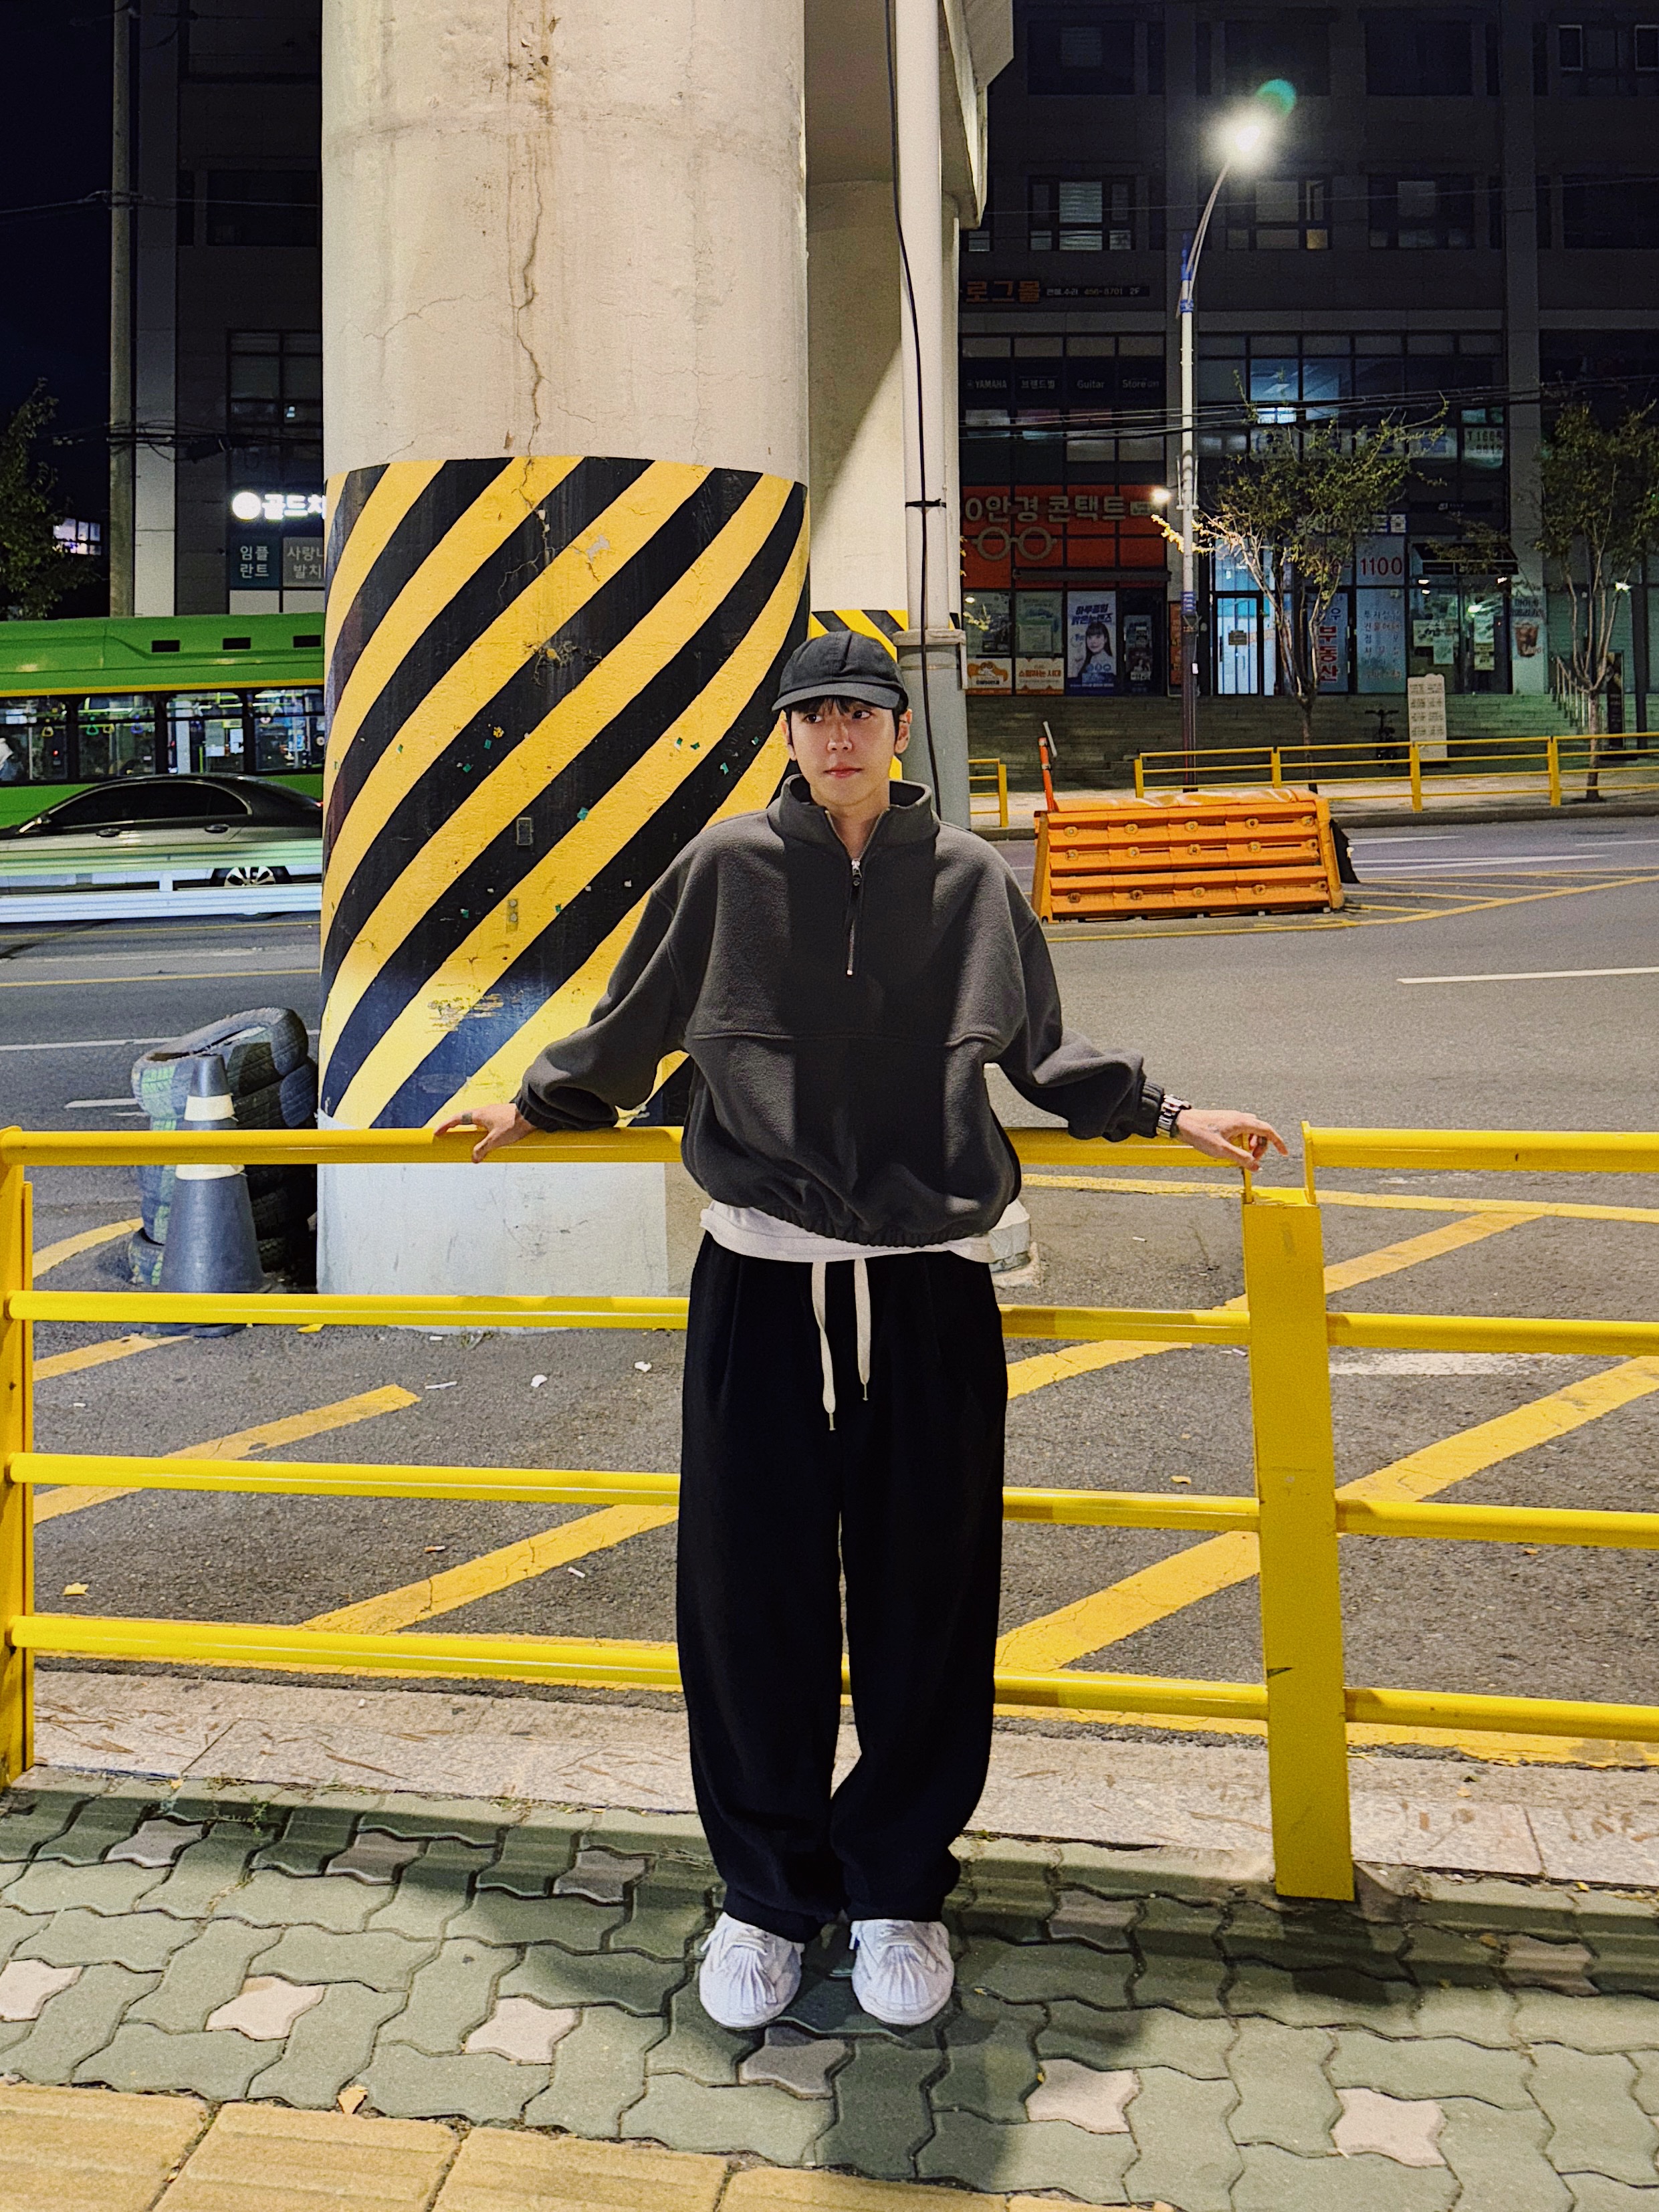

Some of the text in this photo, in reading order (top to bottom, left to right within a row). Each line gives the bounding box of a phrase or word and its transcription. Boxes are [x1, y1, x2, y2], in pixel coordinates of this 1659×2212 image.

[975, 379, 1007, 389] YAMAHA
[1077, 379, 1105, 389] Guitar
[1048, 495, 1127, 523] 콘택트
[240, 546, 269, 561] 임플
[240, 564, 269, 578] 란트
[293, 565, 322, 579] 발치
[1319, 625, 1339, 682] 부동산
